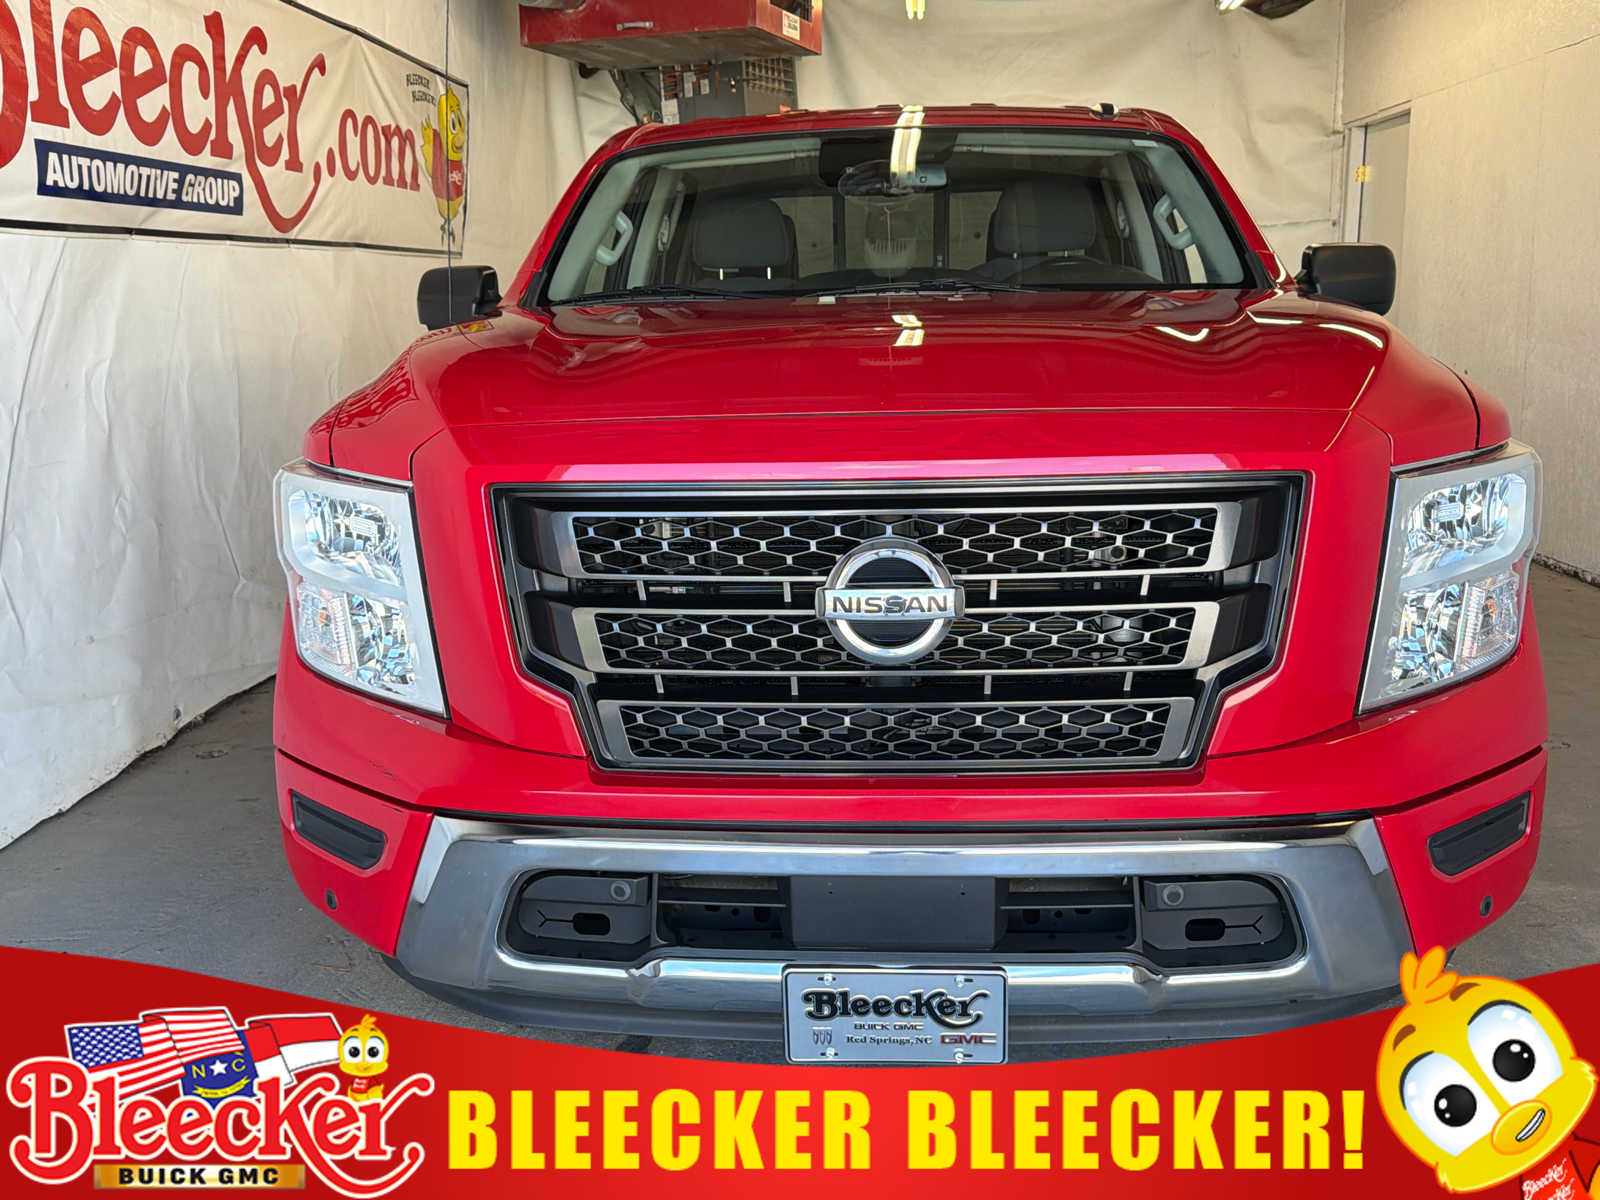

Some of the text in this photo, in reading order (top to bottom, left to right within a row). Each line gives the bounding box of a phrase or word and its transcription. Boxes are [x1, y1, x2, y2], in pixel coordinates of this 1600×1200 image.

[45, 152, 240, 207] AUTOMOTIVE GROUP
[832, 595, 947, 614] NISSAN
[854, 1022, 924, 1031] BUICK GMC
[847, 1035, 867, 1044] Red
[940, 1033, 997, 1045] GMC
